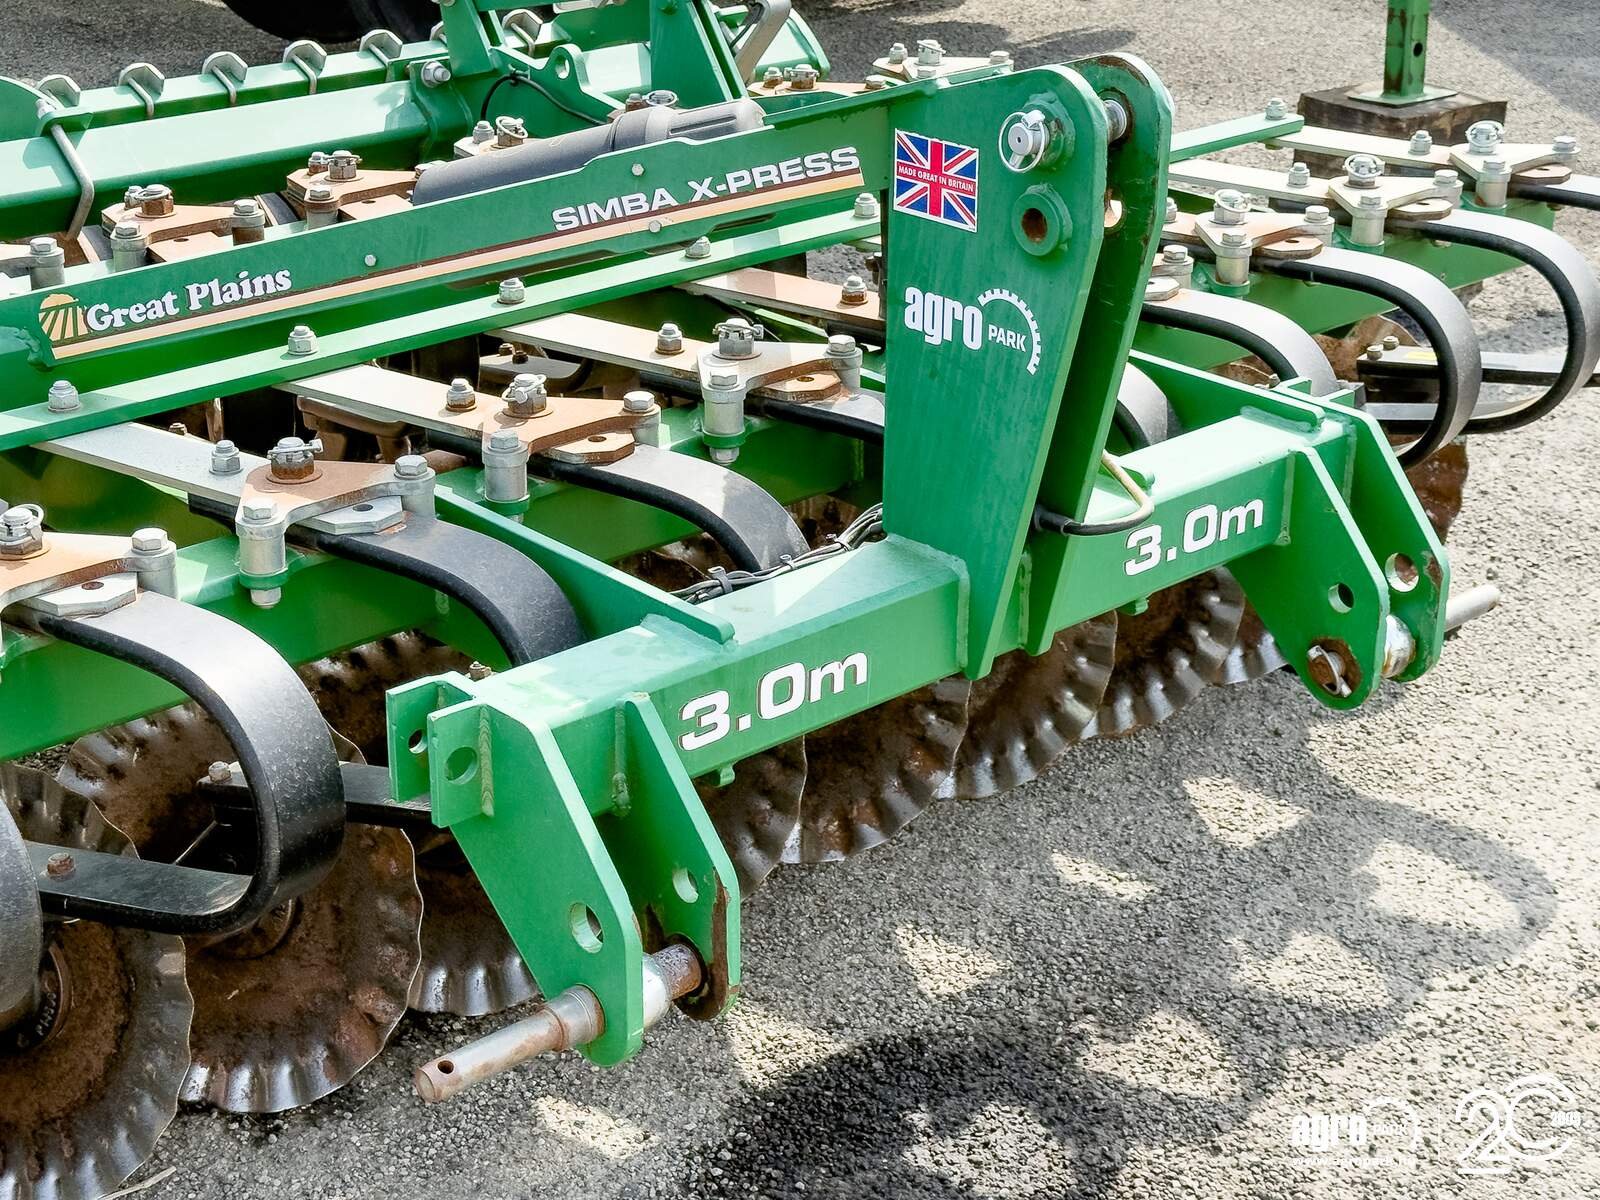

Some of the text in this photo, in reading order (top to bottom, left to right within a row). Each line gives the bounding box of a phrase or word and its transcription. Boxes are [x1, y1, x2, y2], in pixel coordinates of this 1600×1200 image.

[552, 146, 860, 232] SIMBA X-PRESS
[898, 165, 974, 192] MADE GREAT IN BRITAIN
[86, 269, 292, 331] Great Plains
[904, 286, 1027, 352] agro PARK
[1124, 498, 1264, 576] 3.0m
[678, 652, 868, 751] 3.0m
